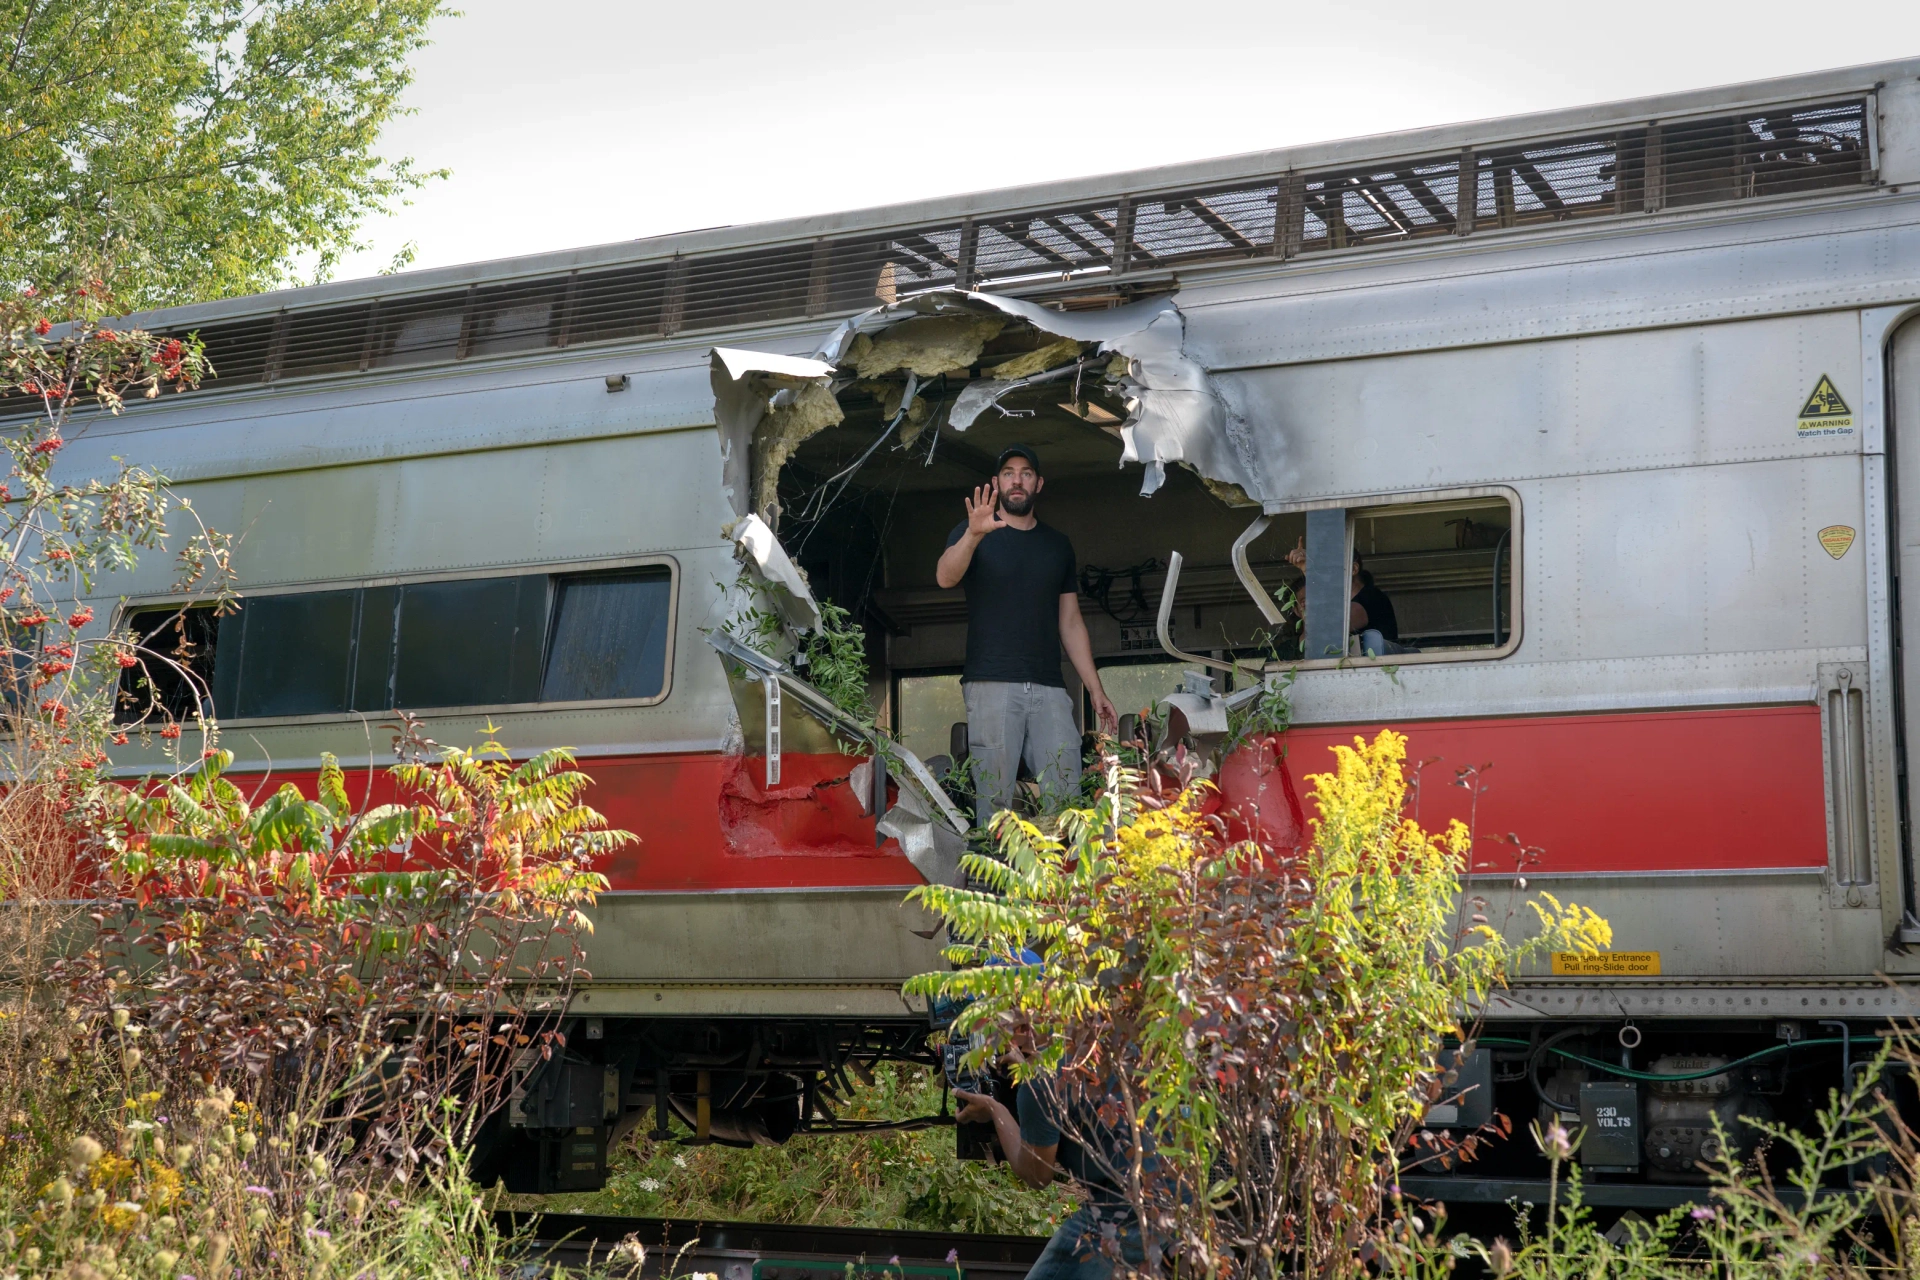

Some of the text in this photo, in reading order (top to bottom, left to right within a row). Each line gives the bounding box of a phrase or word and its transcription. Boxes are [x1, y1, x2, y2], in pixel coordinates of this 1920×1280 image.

[1808, 419, 1850, 428] WARNING
[1797, 427, 1853, 437] Watch the Gap
[1560, 953, 1652, 963] Emergency Entrance
[1564, 963, 1649, 972] Pull ring-Slide door
[1596, 1107, 1617, 1117] 230
[1596, 1117, 1631, 1127] VOLTS
